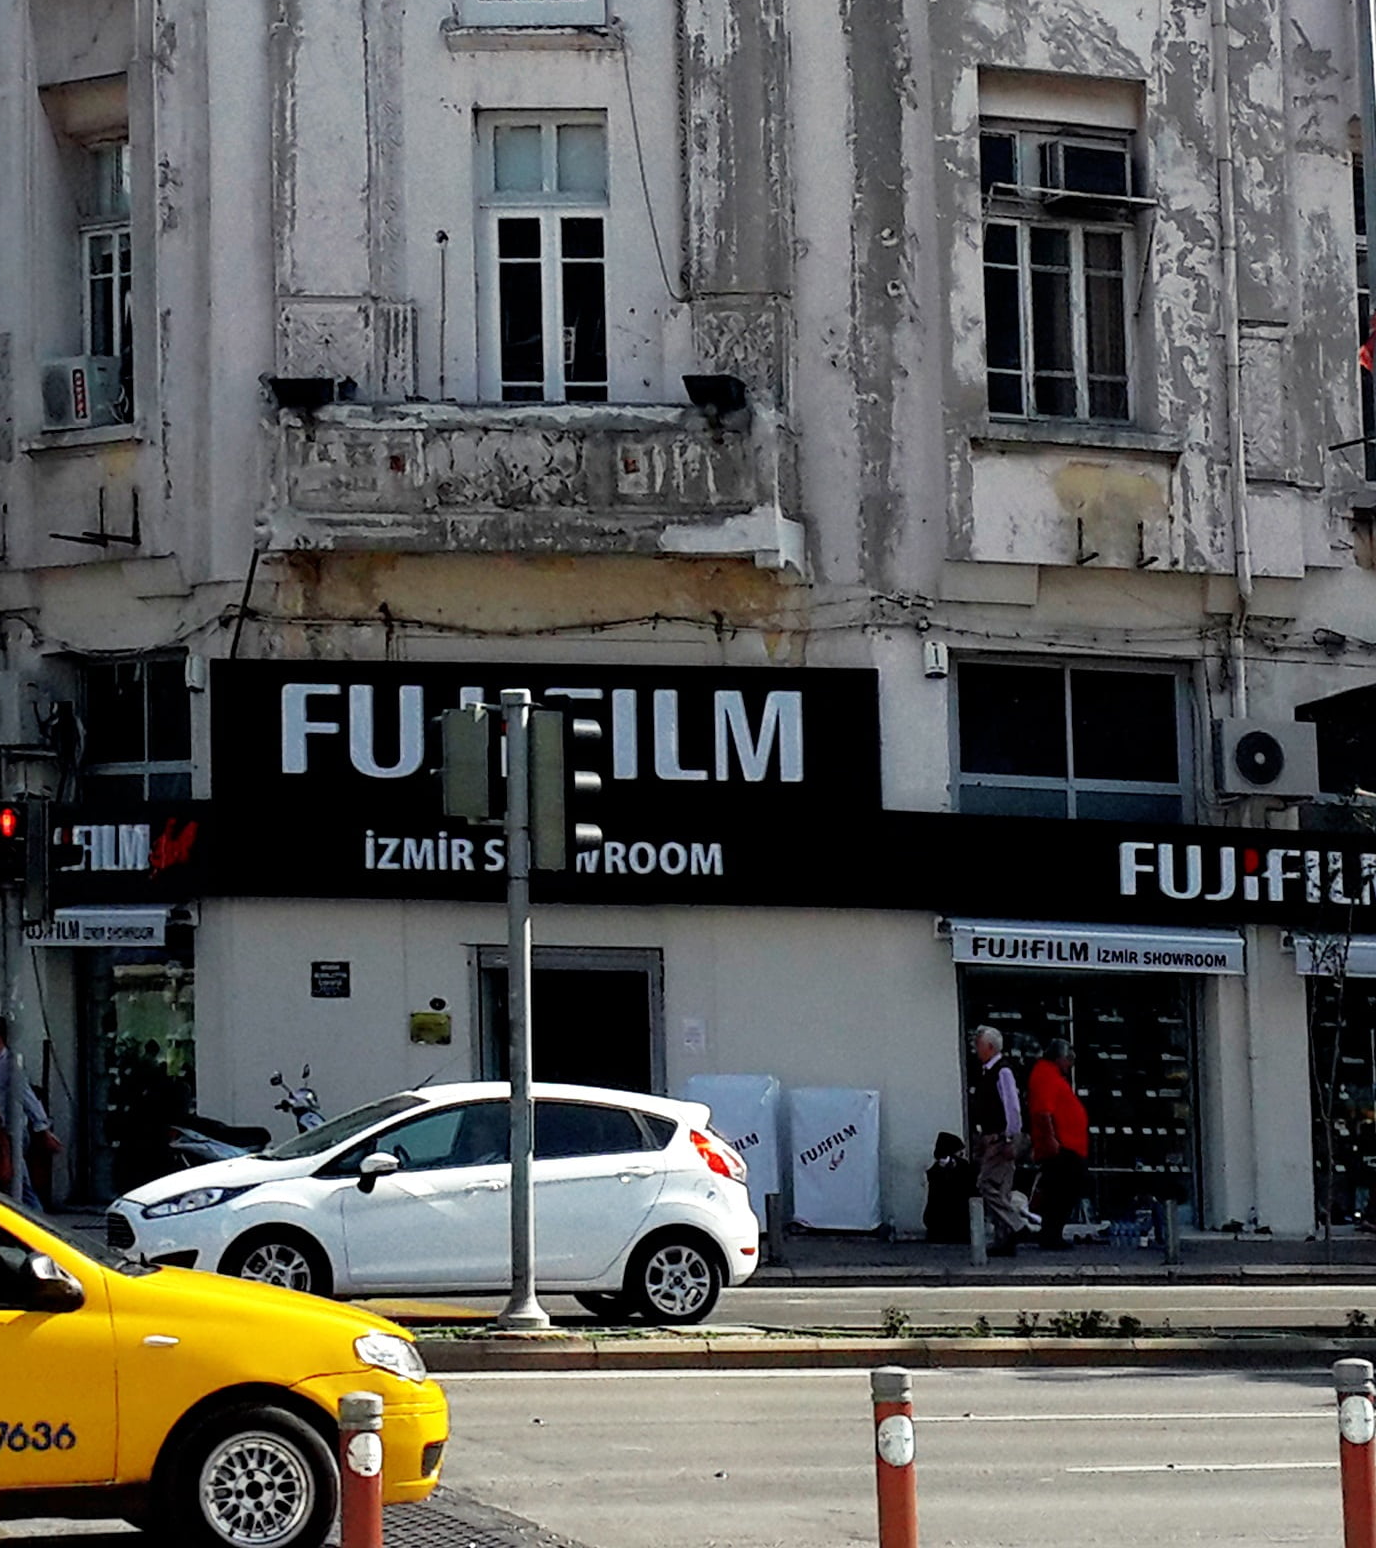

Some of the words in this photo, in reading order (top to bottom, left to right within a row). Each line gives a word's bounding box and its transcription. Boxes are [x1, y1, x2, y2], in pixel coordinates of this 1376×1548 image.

[281, 683, 804, 782] FUILM
[364, 829, 475, 872] İZMİR
[484, 840, 725, 876] SWROOM
[972, 936, 1089, 963] FUJIFILM
[1096, 946, 1138, 965] İZMİR
[1143, 952, 1227, 968] SHOWROOM
[800, 1123, 857, 1166] FUJIFILM
